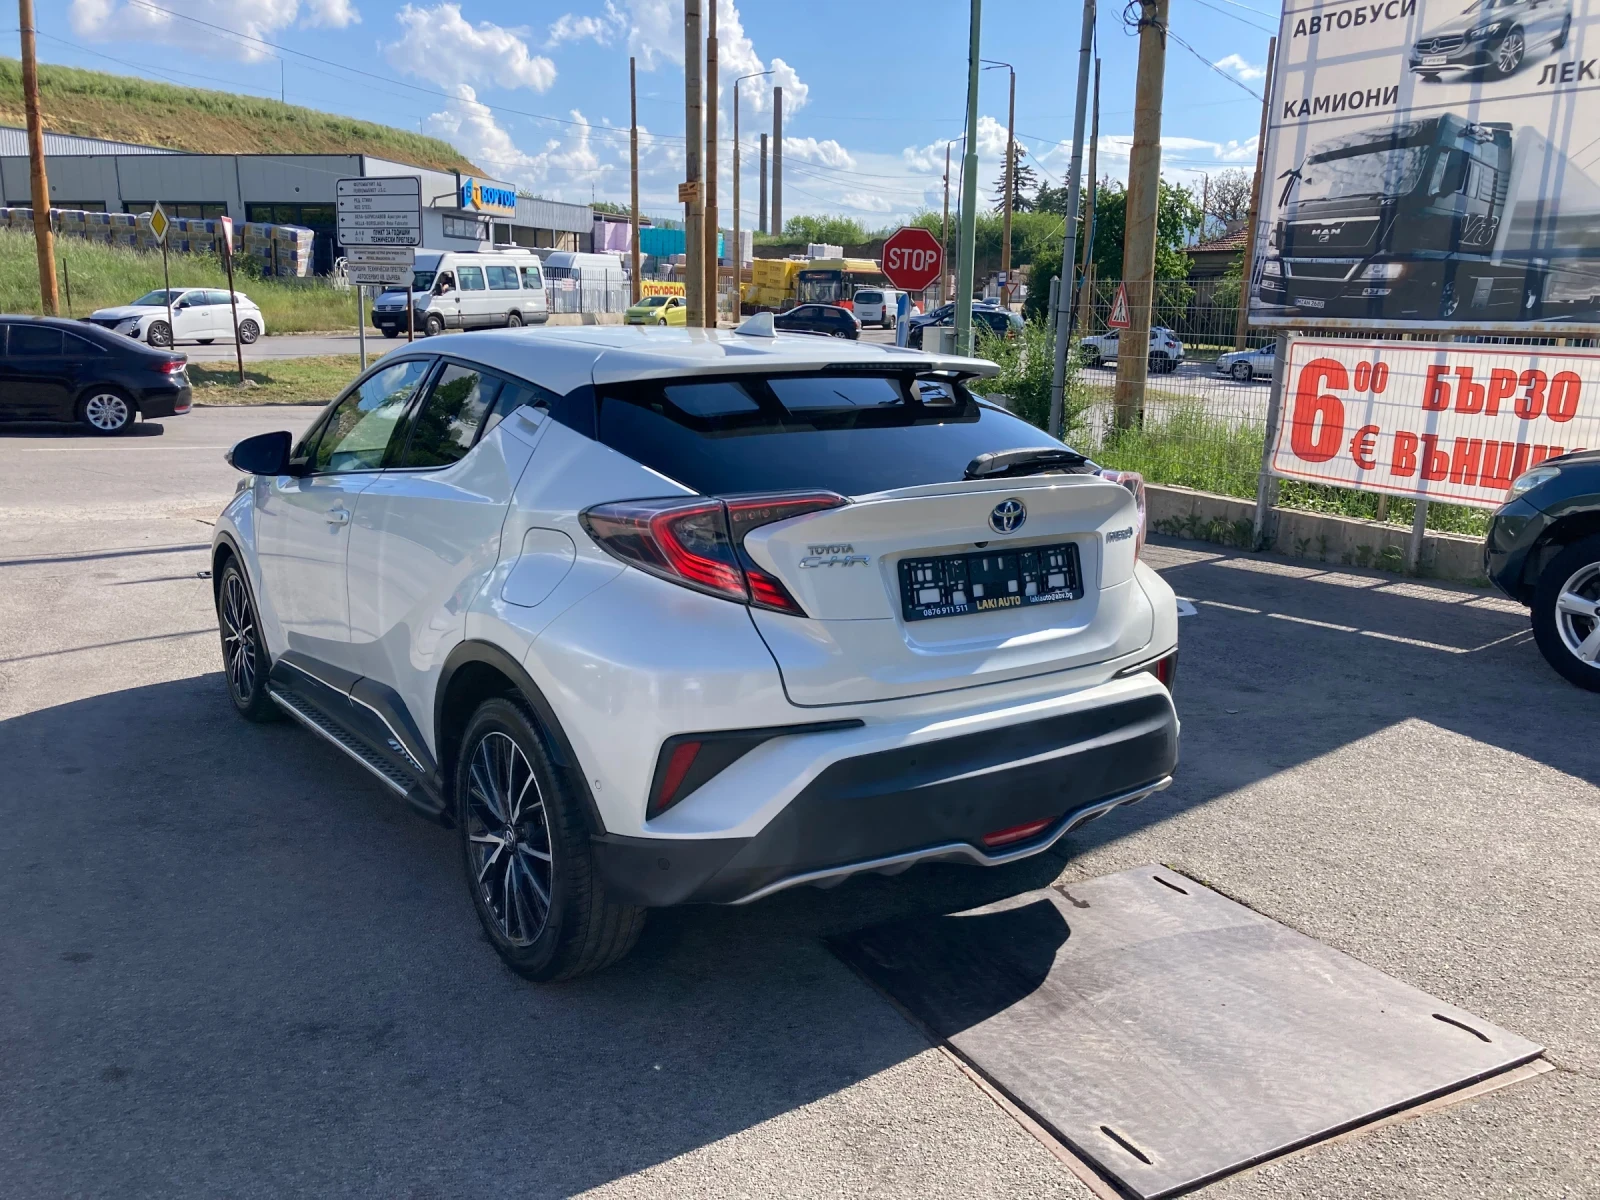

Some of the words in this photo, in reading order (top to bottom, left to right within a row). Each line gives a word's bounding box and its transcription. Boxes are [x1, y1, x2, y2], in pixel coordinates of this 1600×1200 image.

[1293, 0, 1417, 38] АВТОБУСИ
[1537, 58, 1600, 86] ЛЕК
[1283, 85, 1399, 119] КАМИОНИ
[480, 186, 516, 207] БОРТОН
[888, 248, 937, 272] STOP
[1422, 364, 1582, 422] БЪРЗО
[1349, 424, 1380, 470] €
[1390, 430, 1587, 490] ВЪНШ
[799, 555, 870, 568] C-HR
[808, 544, 854, 556] TOYOTA
[976, 598, 997, 610] LAKI
[998, 596, 1021, 607] AUTO
[1030, 592, 1073, 602] lakiauto@abv.bg
[923, 606, 941, 617] 0876
[942, 606, 954, 614] 911
[956, 604, 968, 613] 511
